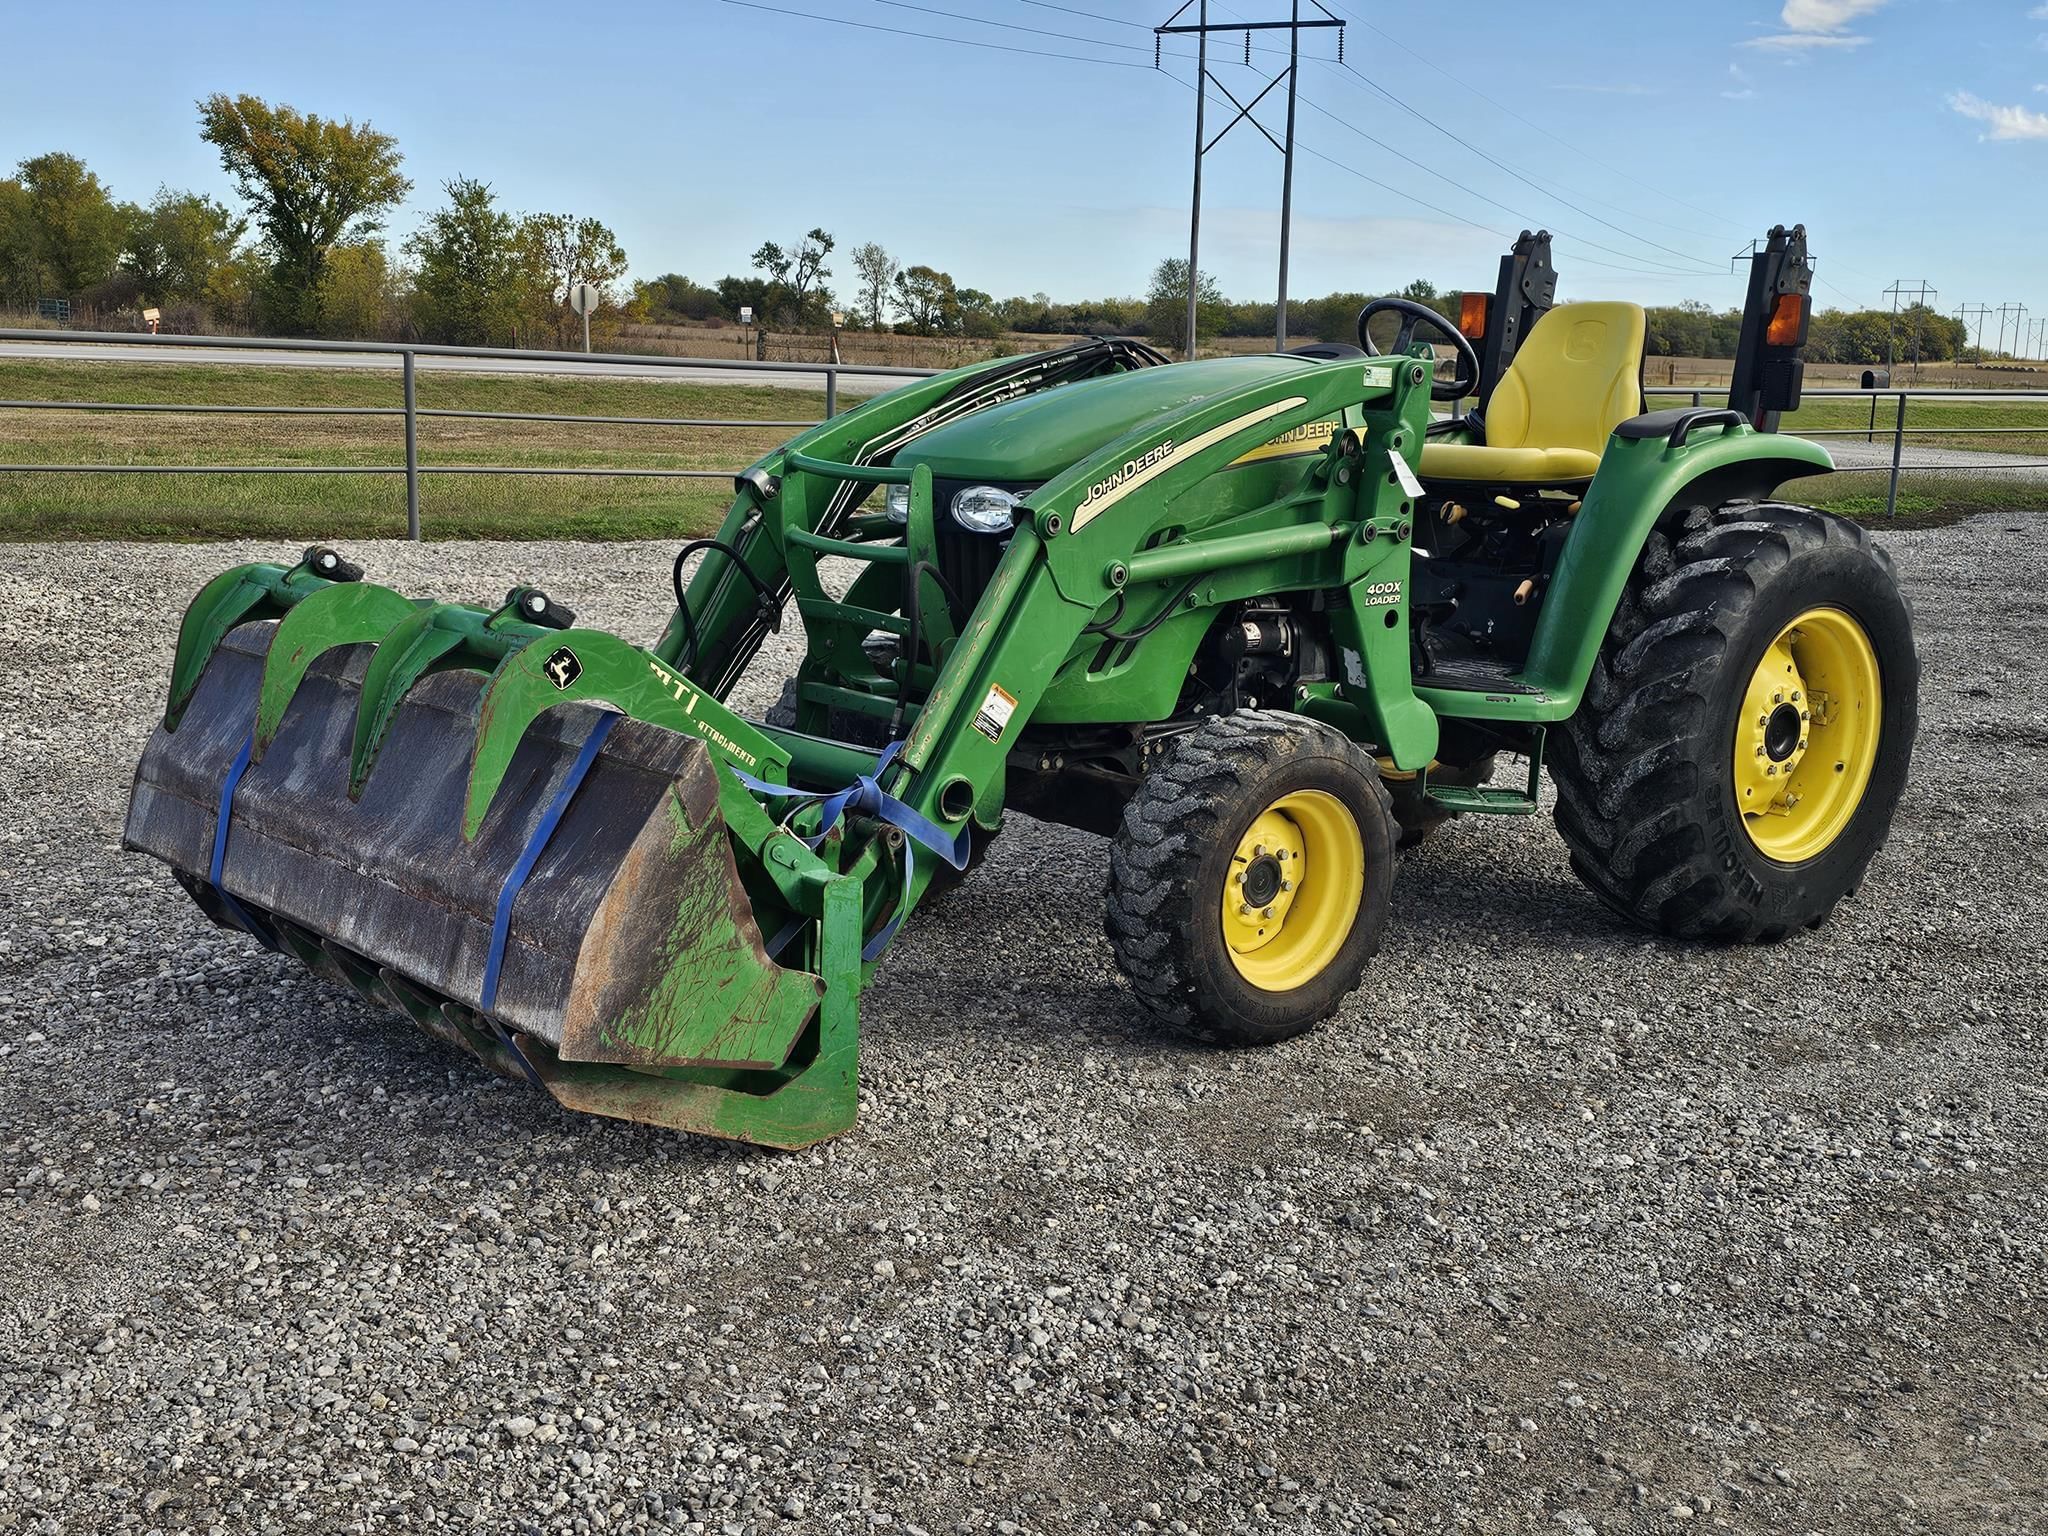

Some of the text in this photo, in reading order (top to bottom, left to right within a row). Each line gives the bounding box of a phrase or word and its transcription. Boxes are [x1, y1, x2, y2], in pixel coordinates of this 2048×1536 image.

[1082, 439, 1174, 507] JOHN DEERE
[1366, 581, 1402, 595] 400X
[1364, 595, 1401, 606] LOADER
